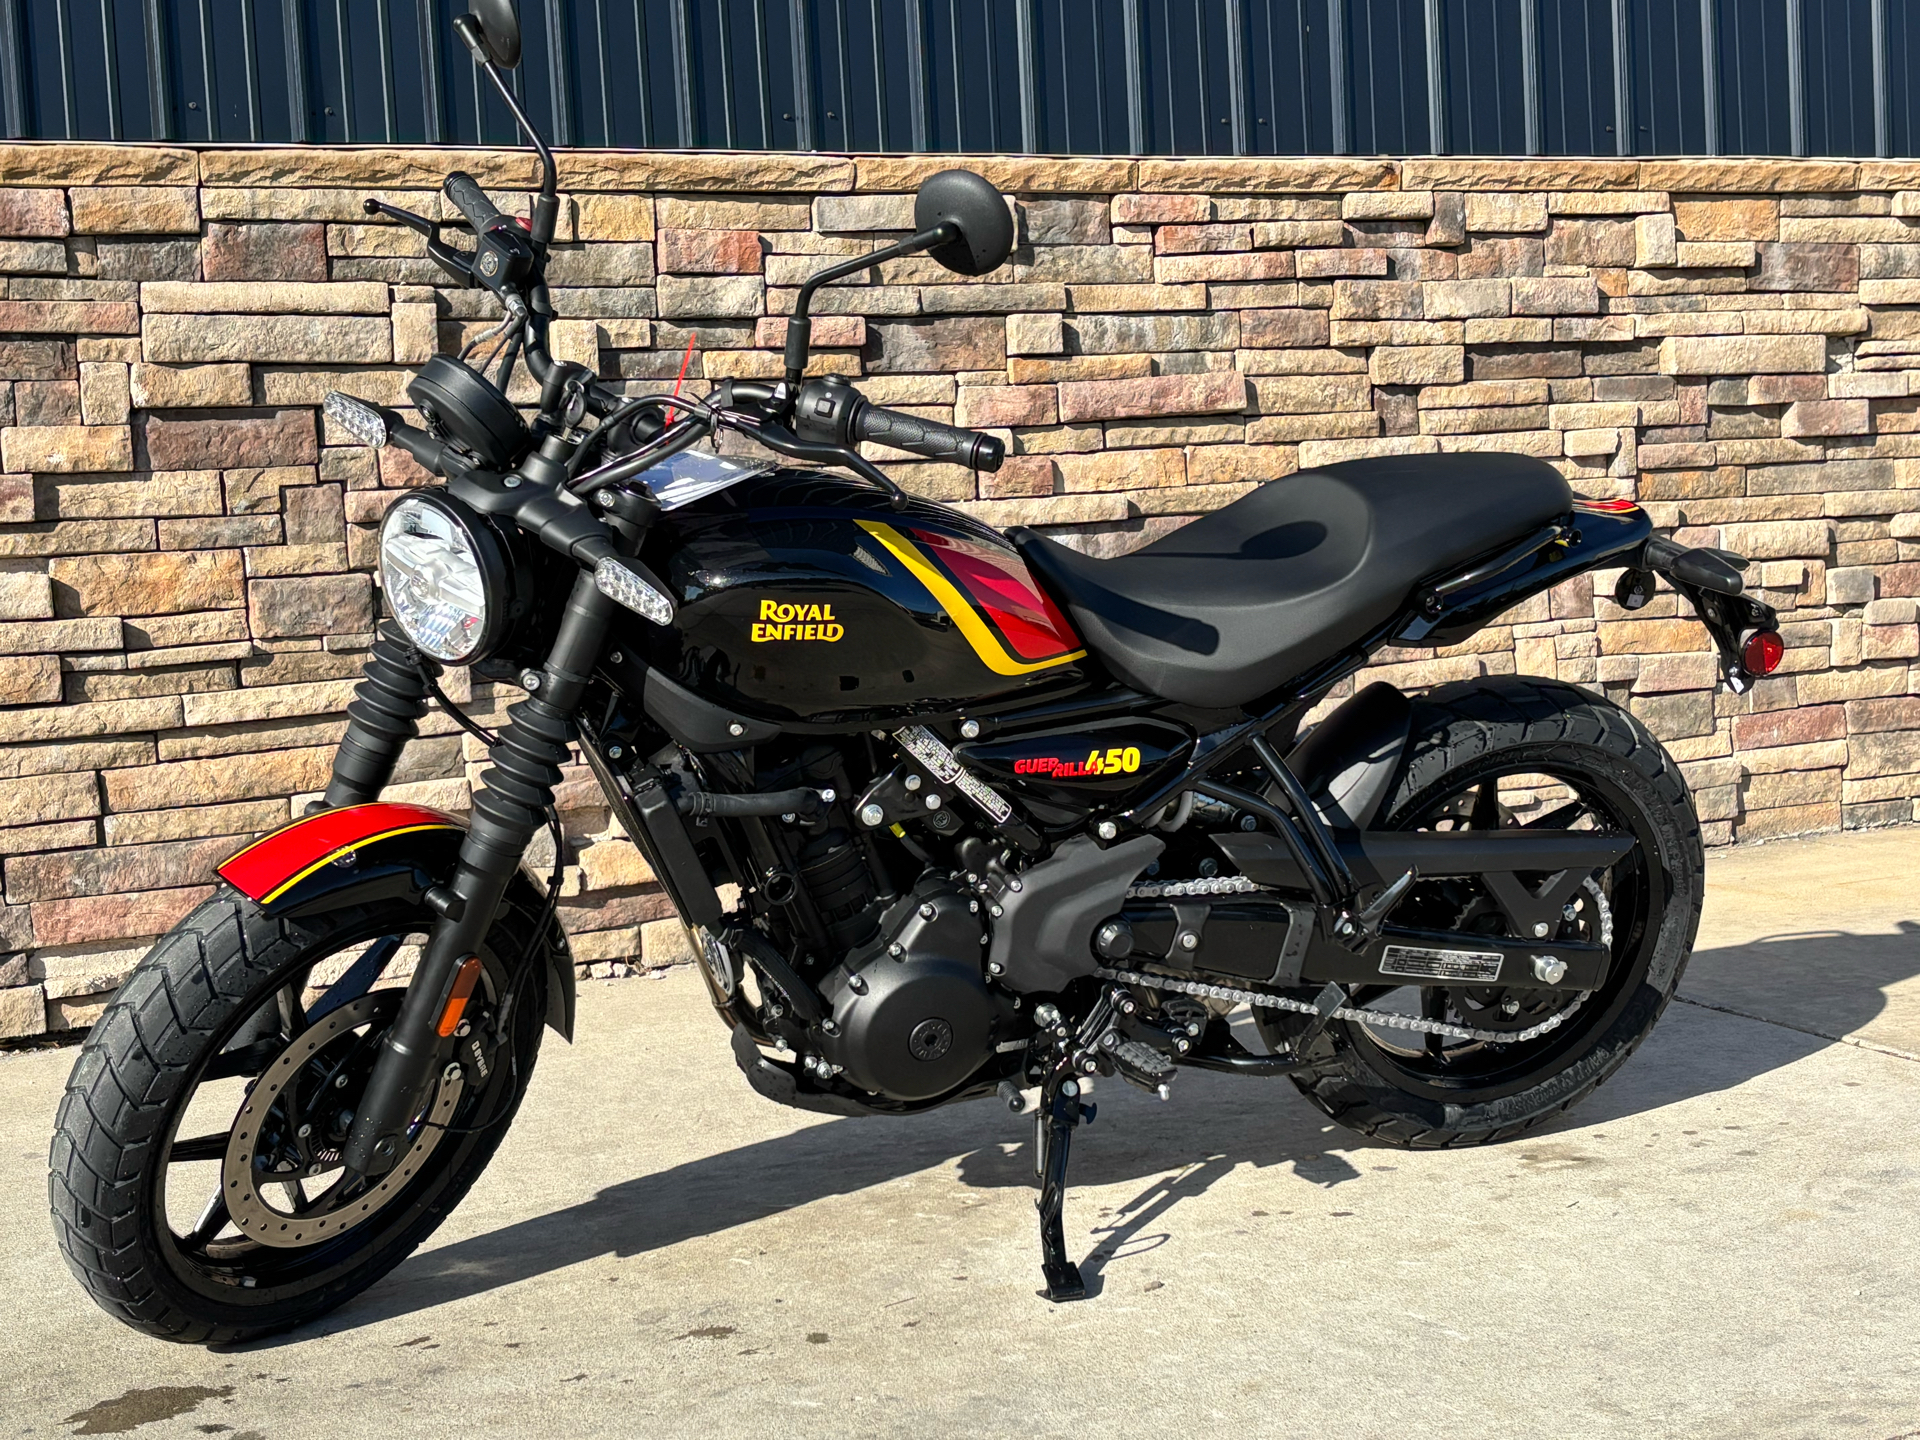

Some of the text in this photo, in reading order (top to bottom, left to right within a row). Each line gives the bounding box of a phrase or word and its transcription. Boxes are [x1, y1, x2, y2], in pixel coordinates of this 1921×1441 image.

[760, 599, 835, 623] ROYAL
[751, 623, 844, 642] ENFIELD
[1085, 746, 1141, 775] 450
